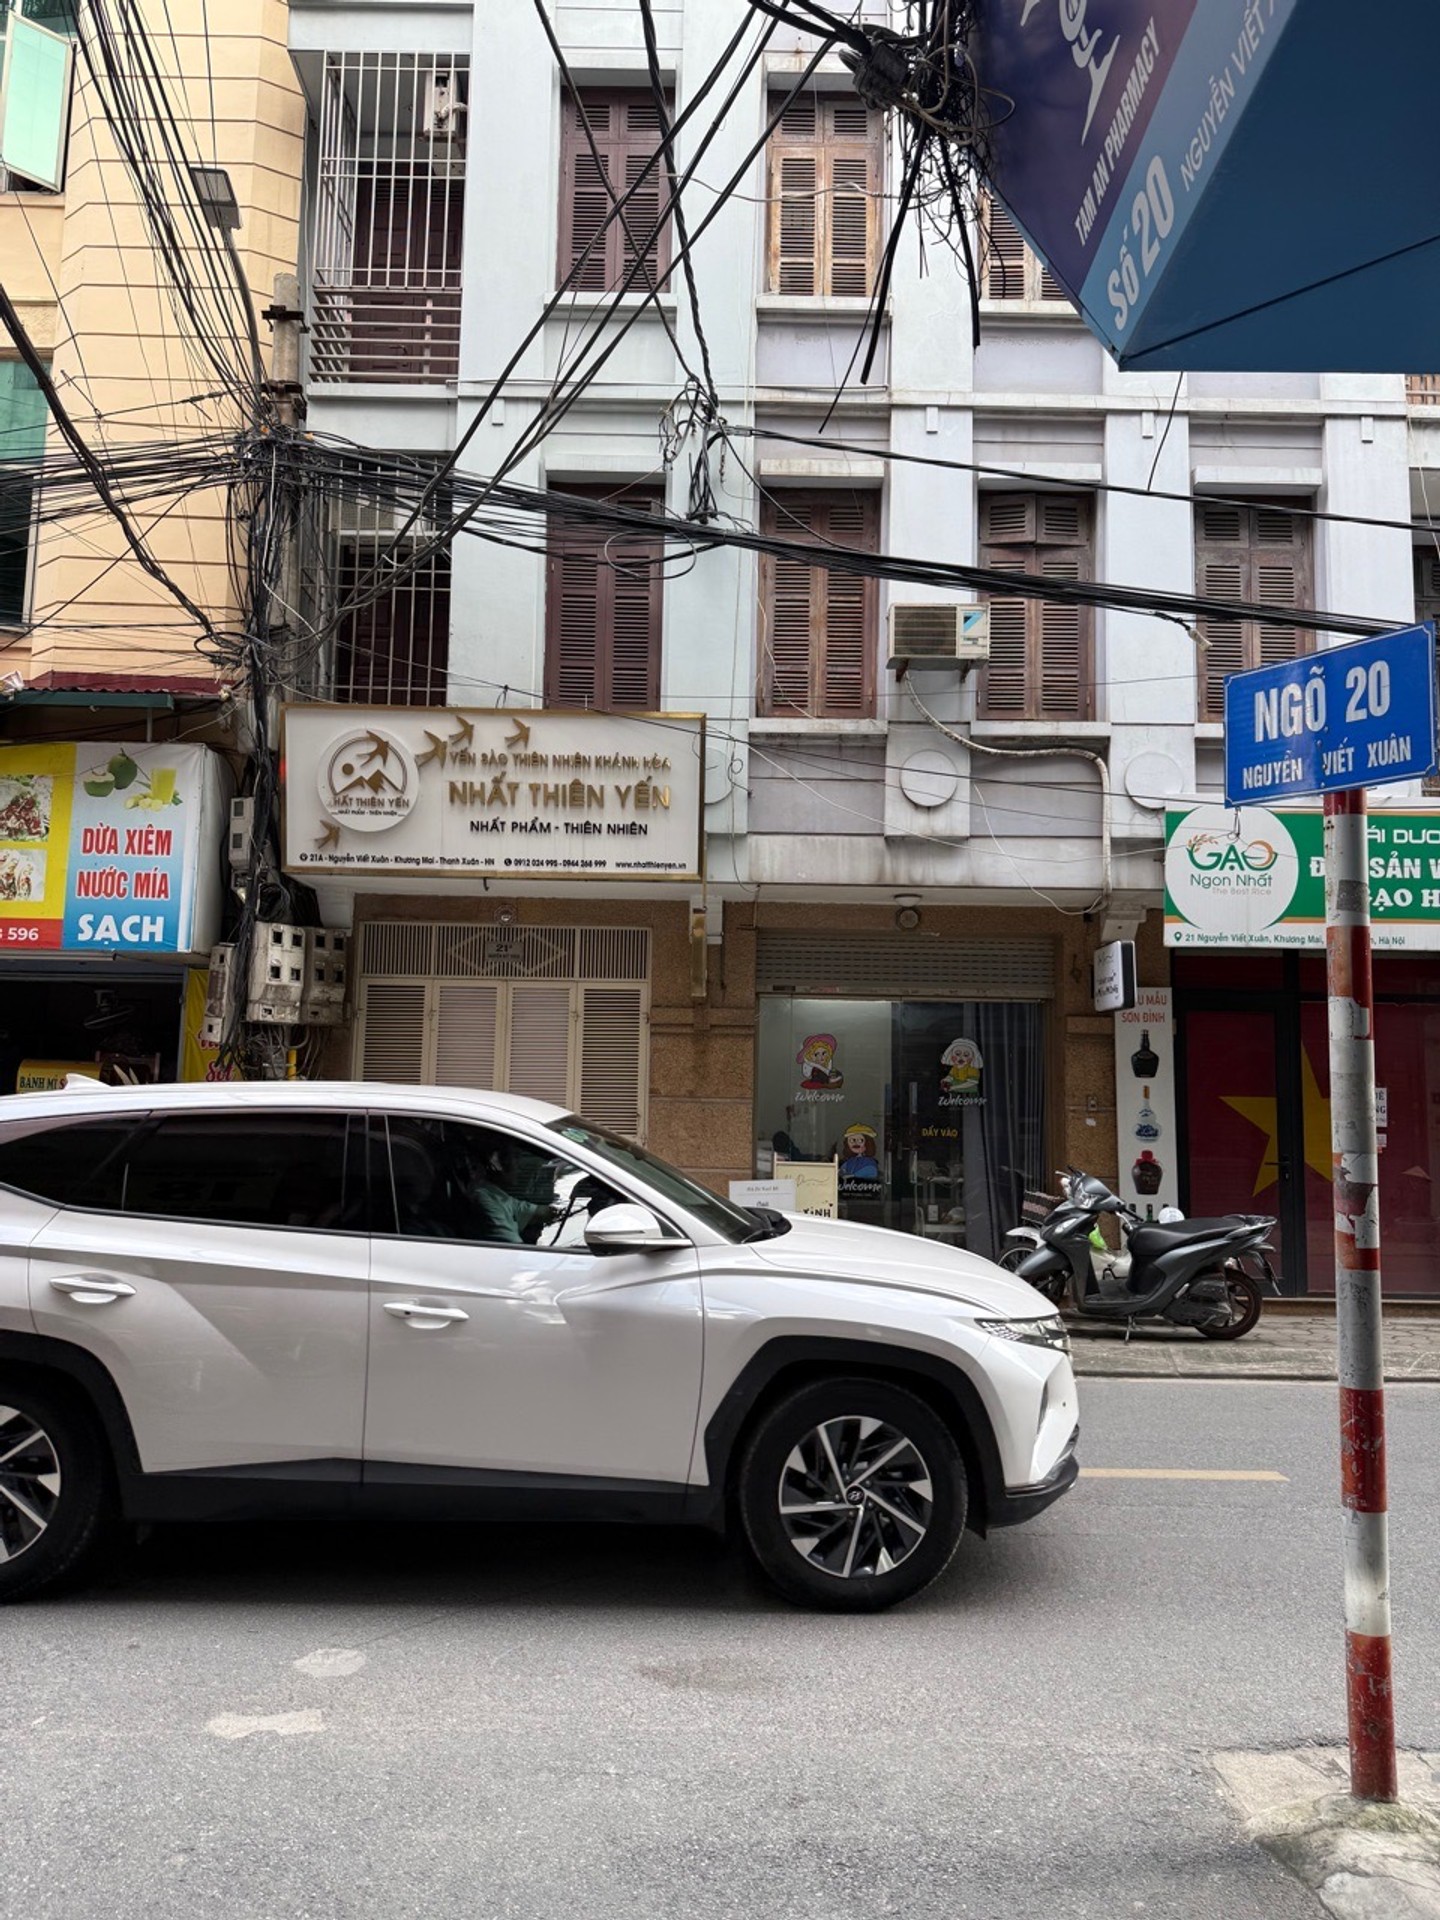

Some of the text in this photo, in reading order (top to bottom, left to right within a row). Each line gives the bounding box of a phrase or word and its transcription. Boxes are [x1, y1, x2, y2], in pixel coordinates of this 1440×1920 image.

[1074, 16, 1160, 246] TAM AN PHARMACY
[1131, 155, 1175, 278] 20
[1179, 67, 1237, 192] NGUYỄN
[1254, 660, 1391, 743] NGÕ 20
[449, 747, 477, 766] YẾN
[512, 751, 549, 768] THIÊN
[552, 752, 591, 768] NHIÊN
[595, 752, 639, 769] KHÁNH
[1242, 733, 1411, 790] NGUYỄN VIẾT XUÂN
[356, 796, 385, 807] THIÊN
[388, 795, 410, 808] YẾN
[449, 771, 671, 810] NHẤT THIÊN YẾN
[470, 817, 648, 835] NHẤT PHẨM THIÊN NHIÊN
[82, 822, 173, 856] DỪA XIÊM
[1186, 840, 1278, 871] GẠO
[1369, 850, 1421, 879] SẢN
[77, 865, 170, 899] NƯỚC MÍA
[1190, 872, 1273, 888] Ngon Nhất
[1230, 887, 1250, 896] Best
[1250, 887, 1272, 896] Rice
[1368, 888, 1413, 911] ẠO
[7, 927, 39, 941] 596
[78, 914, 165, 945] SẠCH
[1185, 934, 1195, 942] 21
[1197, 932, 1229, 944] Nguyễn
[1231, 933, 1247, 942] Viết
[1248, 934, 1272, 944] Xuân,
[1378, 936, 1390, 945] Hà
[1391, 936, 1406, 945] Nội
[19, 1073, 45, 1089] BÁNH
[794, 1088, 846, 1103] Welcome
[937, 1094, 988, 1107] Welcome
